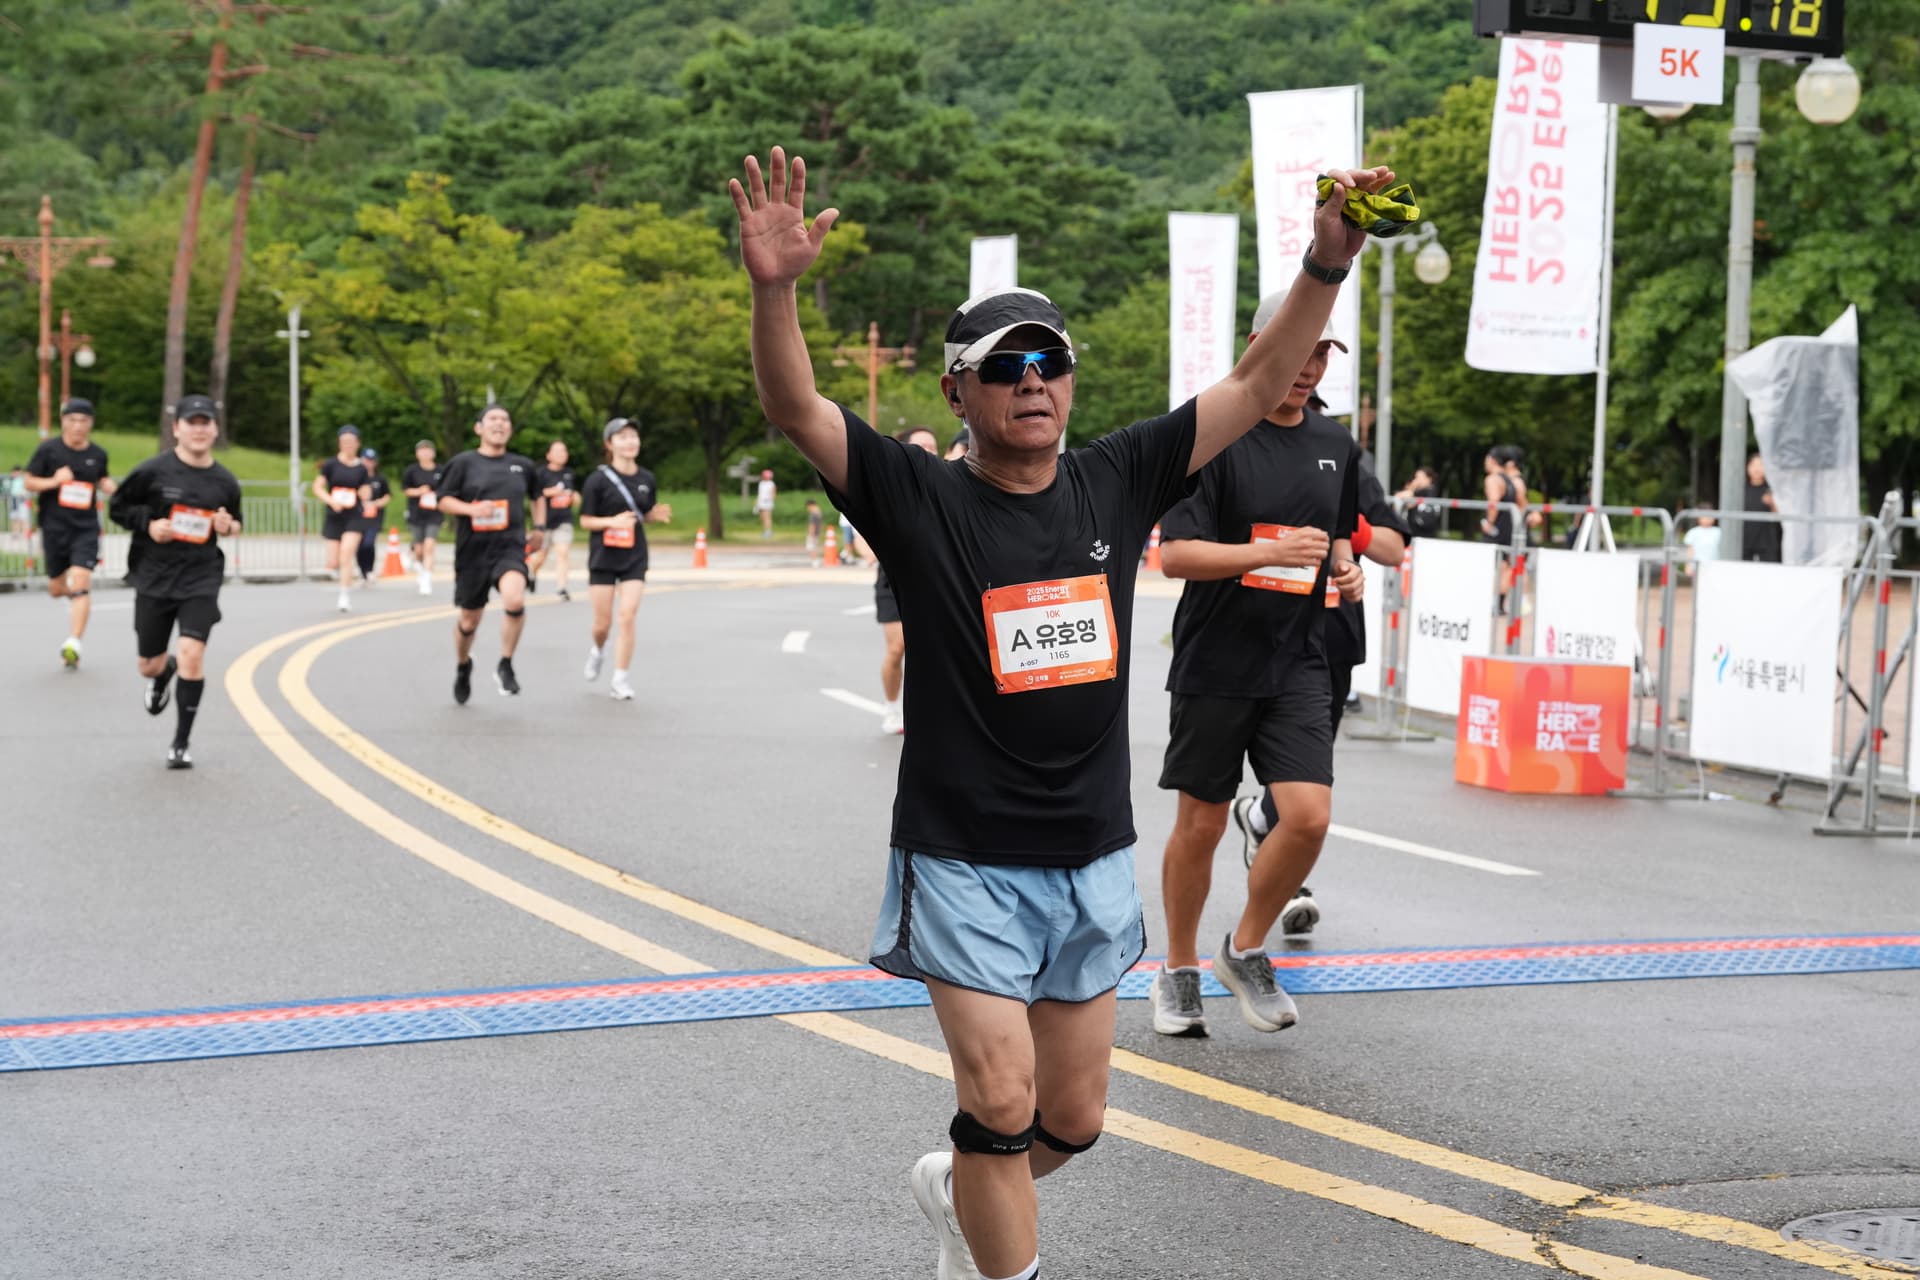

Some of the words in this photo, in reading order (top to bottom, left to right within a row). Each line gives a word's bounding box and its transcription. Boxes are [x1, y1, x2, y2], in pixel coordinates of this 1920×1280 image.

[1660, 48, 1700, 78] 5K
[1045, 610, 1060, 619] 10K
[1011, 629, 1032, 652] A
[1036, 618, 1097, 649] 유호영
[1431, 613, 1471, 642] Brand
[1020, 659, 1038, 668] A-057
[1049, 650, 1070, 660] 1165
[1730, 657, 1806, 694] 서울특별시
[1537, 712, 1602, 733] HERO
[1536, 732, 1601, 753] RACE
